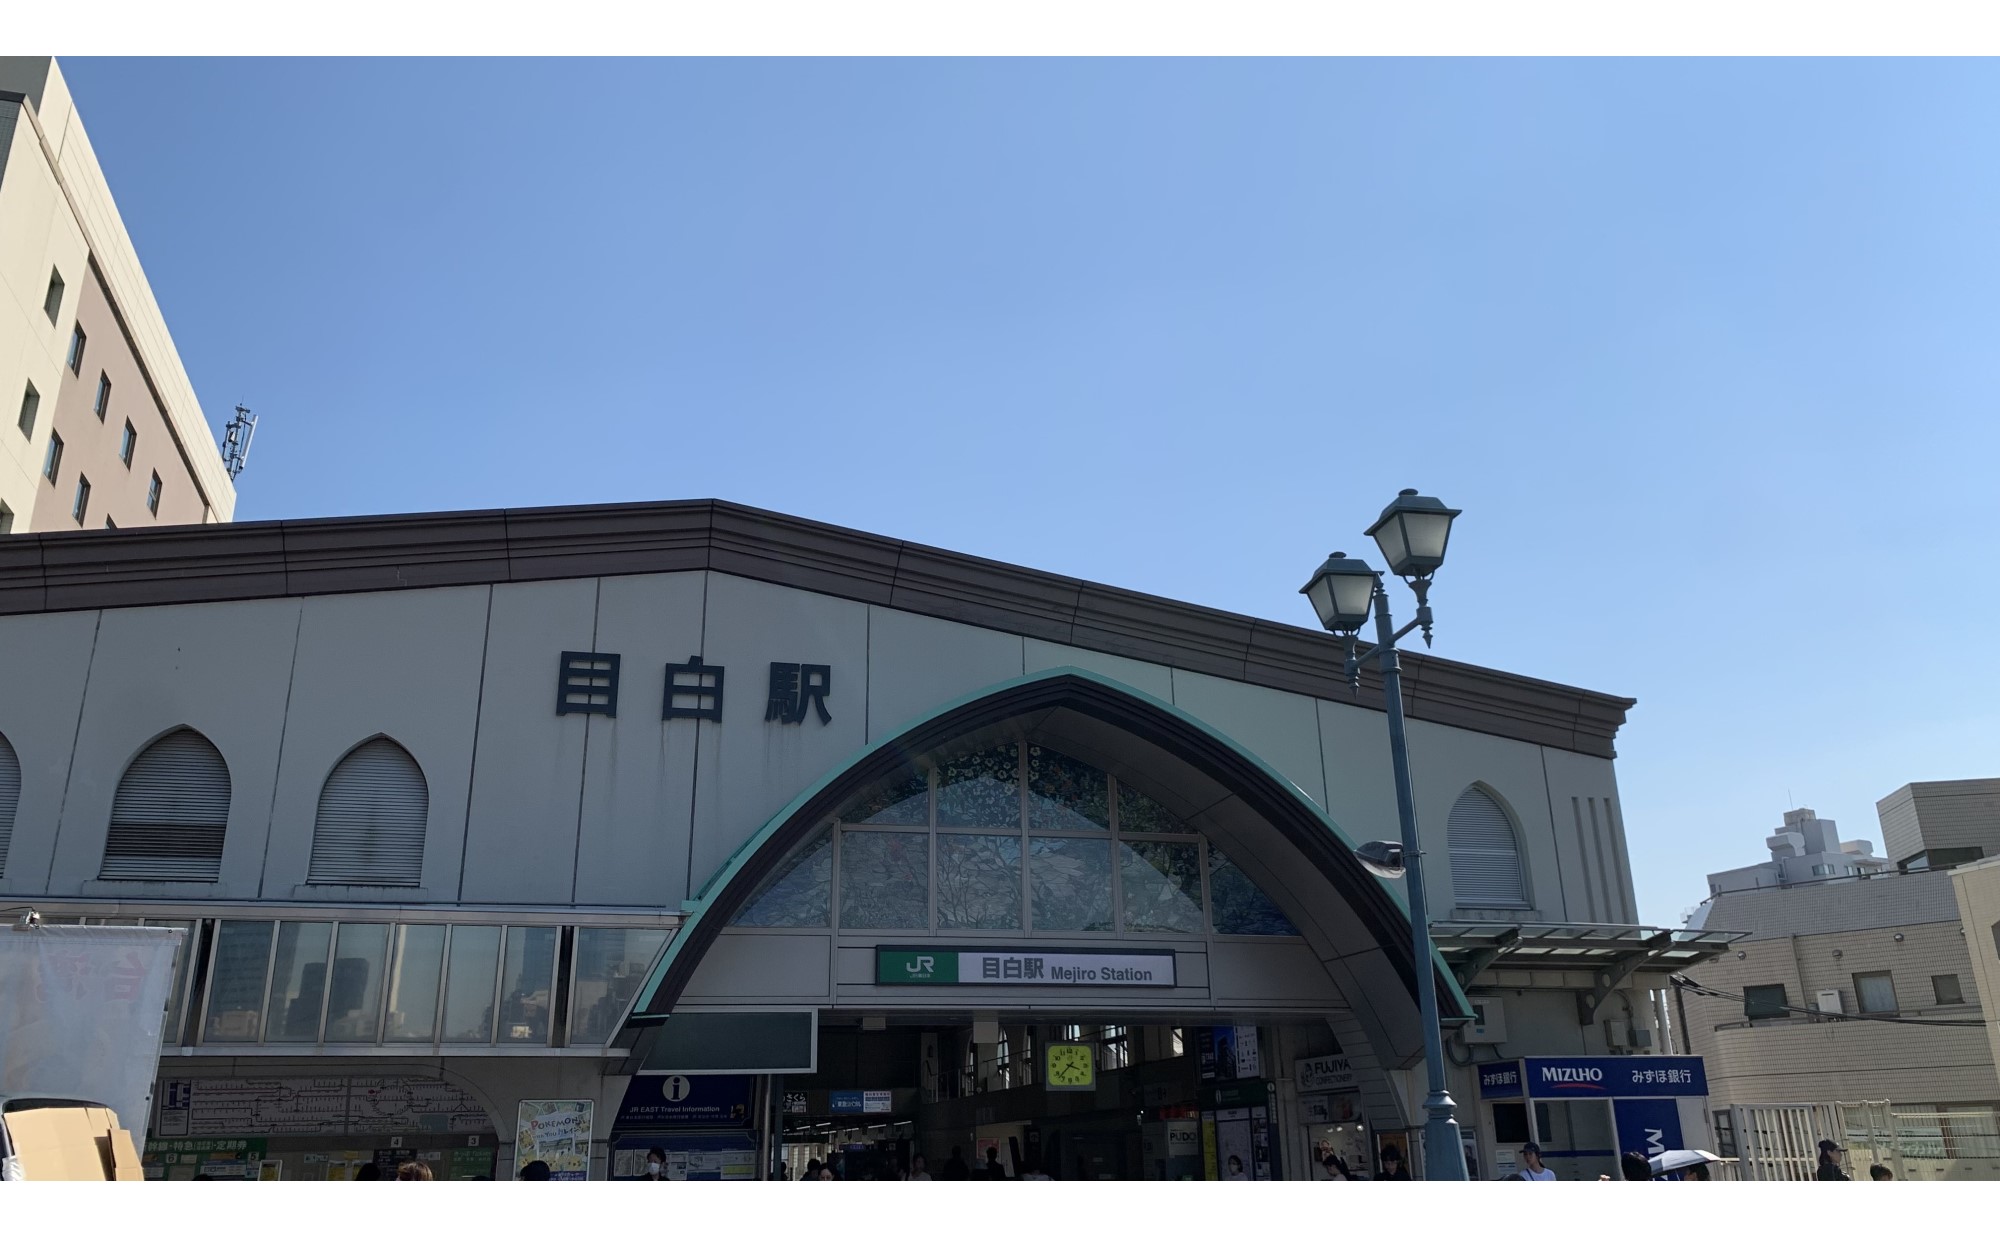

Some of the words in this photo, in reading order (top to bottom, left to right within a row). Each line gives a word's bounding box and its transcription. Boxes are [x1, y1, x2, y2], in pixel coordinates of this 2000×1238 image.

[556, 651, 832, 726] 目白駅
[906, 956, 934, 972] JR
[982, 957, 1043, 978] 目白駅
[1051, 967, 1096, 983] Mejiro
[1101, 967, 1152, 980] Station
[1314, 1058, 1351, 1074] FUJIYA
[1483, 1071, 1518, 1086] みずほ銀行
[1542, 1067, 1602, 1082] MIZUHO
[1631, 1069, 1692, 1084] みずほ銀行
[1170, 1132, 1196, 1141] PUDO
